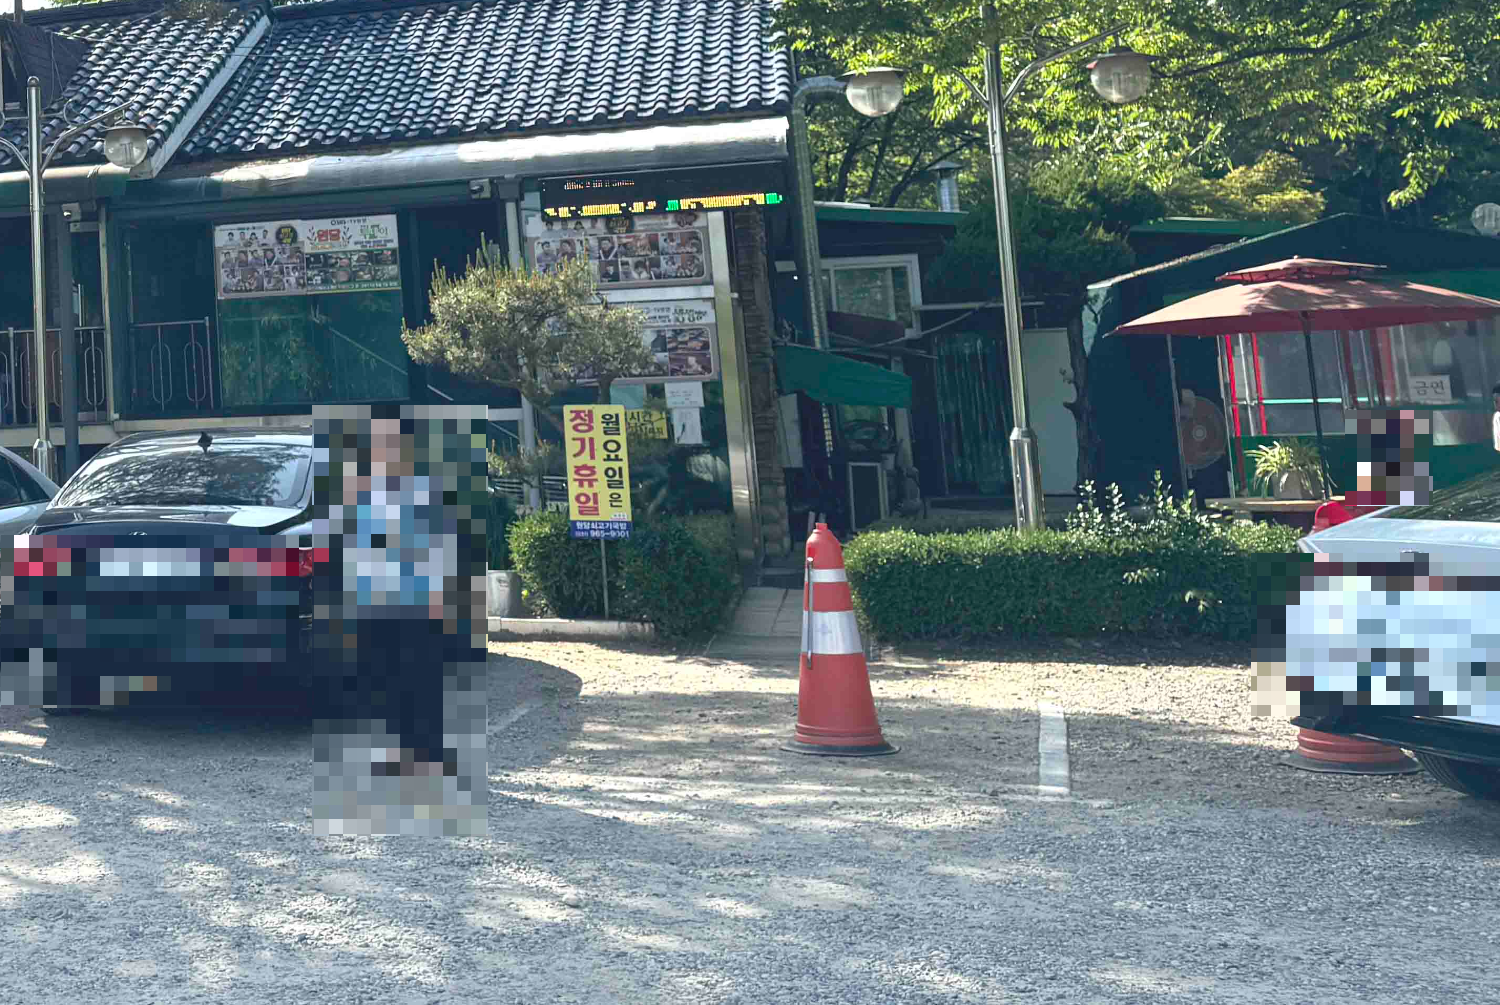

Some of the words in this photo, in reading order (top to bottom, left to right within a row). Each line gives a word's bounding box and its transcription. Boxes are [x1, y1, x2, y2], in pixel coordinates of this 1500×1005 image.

[1414, 380, 1446, 396] 금연
[569, 409, 600, 516] 정기휴일
[601, 413, 625, 508] 월요일은
